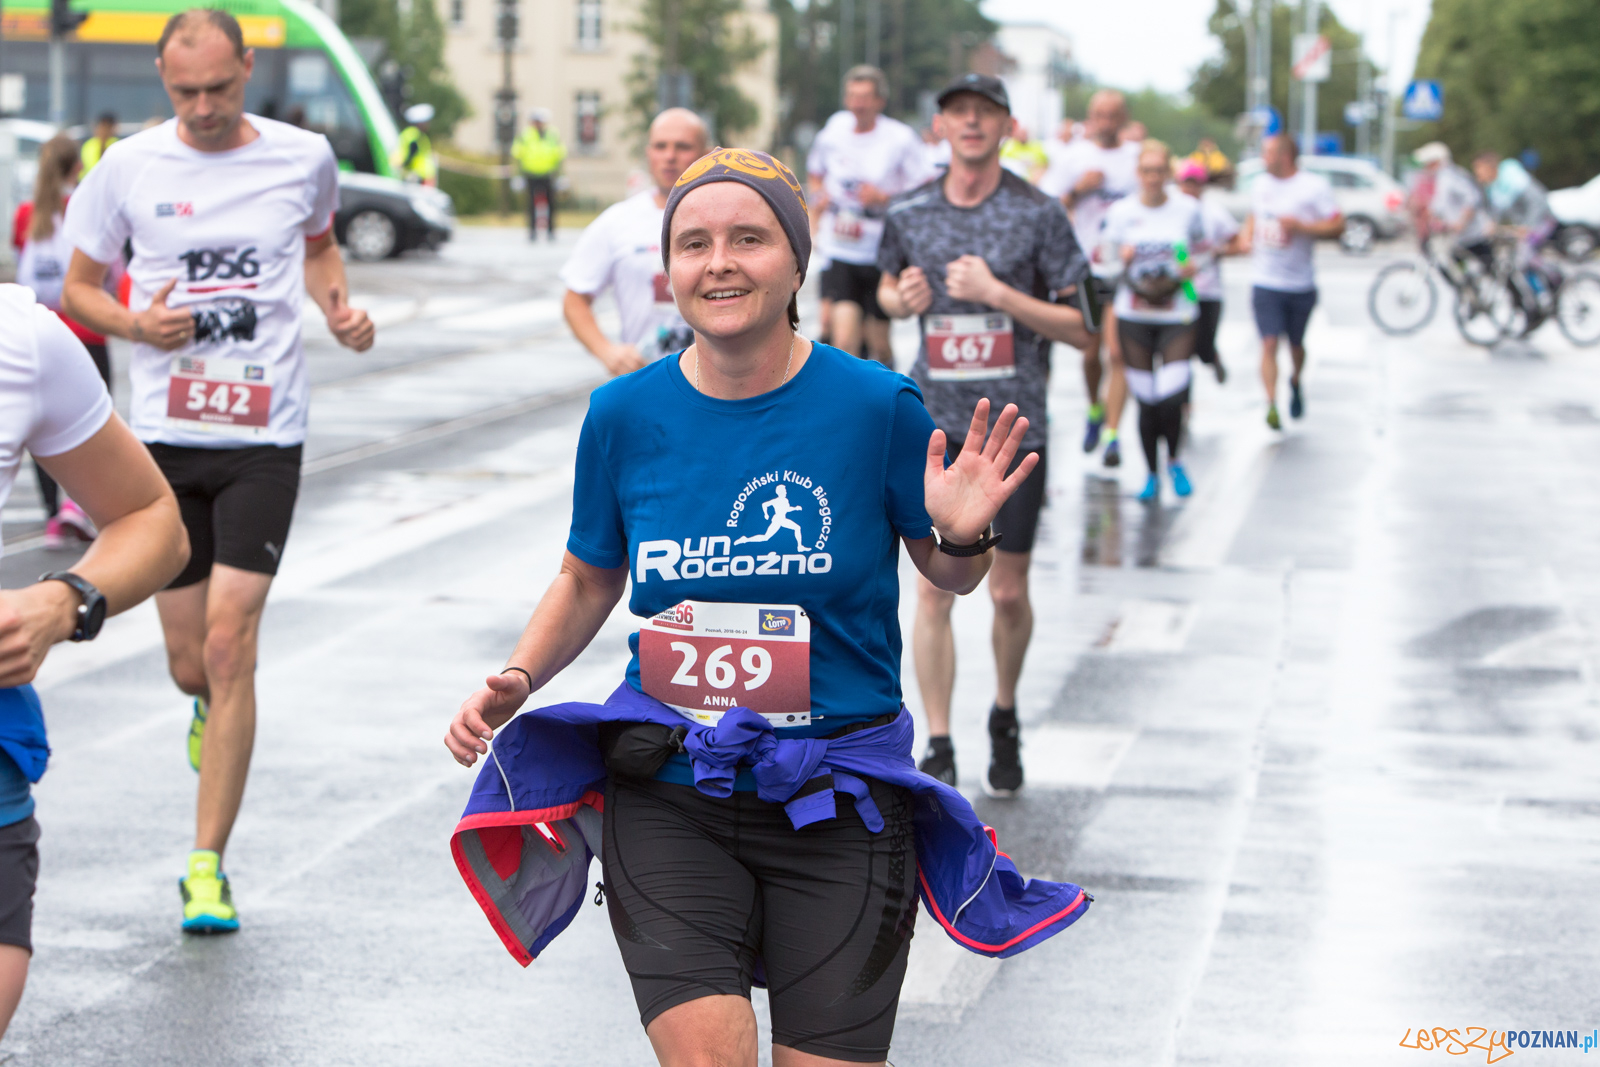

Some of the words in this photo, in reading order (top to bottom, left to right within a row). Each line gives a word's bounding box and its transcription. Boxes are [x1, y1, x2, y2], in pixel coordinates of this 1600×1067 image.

[178, 247, 260, 282] 1956
[941, 336, 995, 363] 667
[186, 381, 251, 415] 542
[726, 470, 779, 528] Rogoziński
[783, 470, 813, 489] Klub
[812, 485, 832, 551] Biegacza
[768, 619, 787, 629] LOTTO
[670, 641, 773, 691] 269
[703, 695, 738, 707] ANNA
